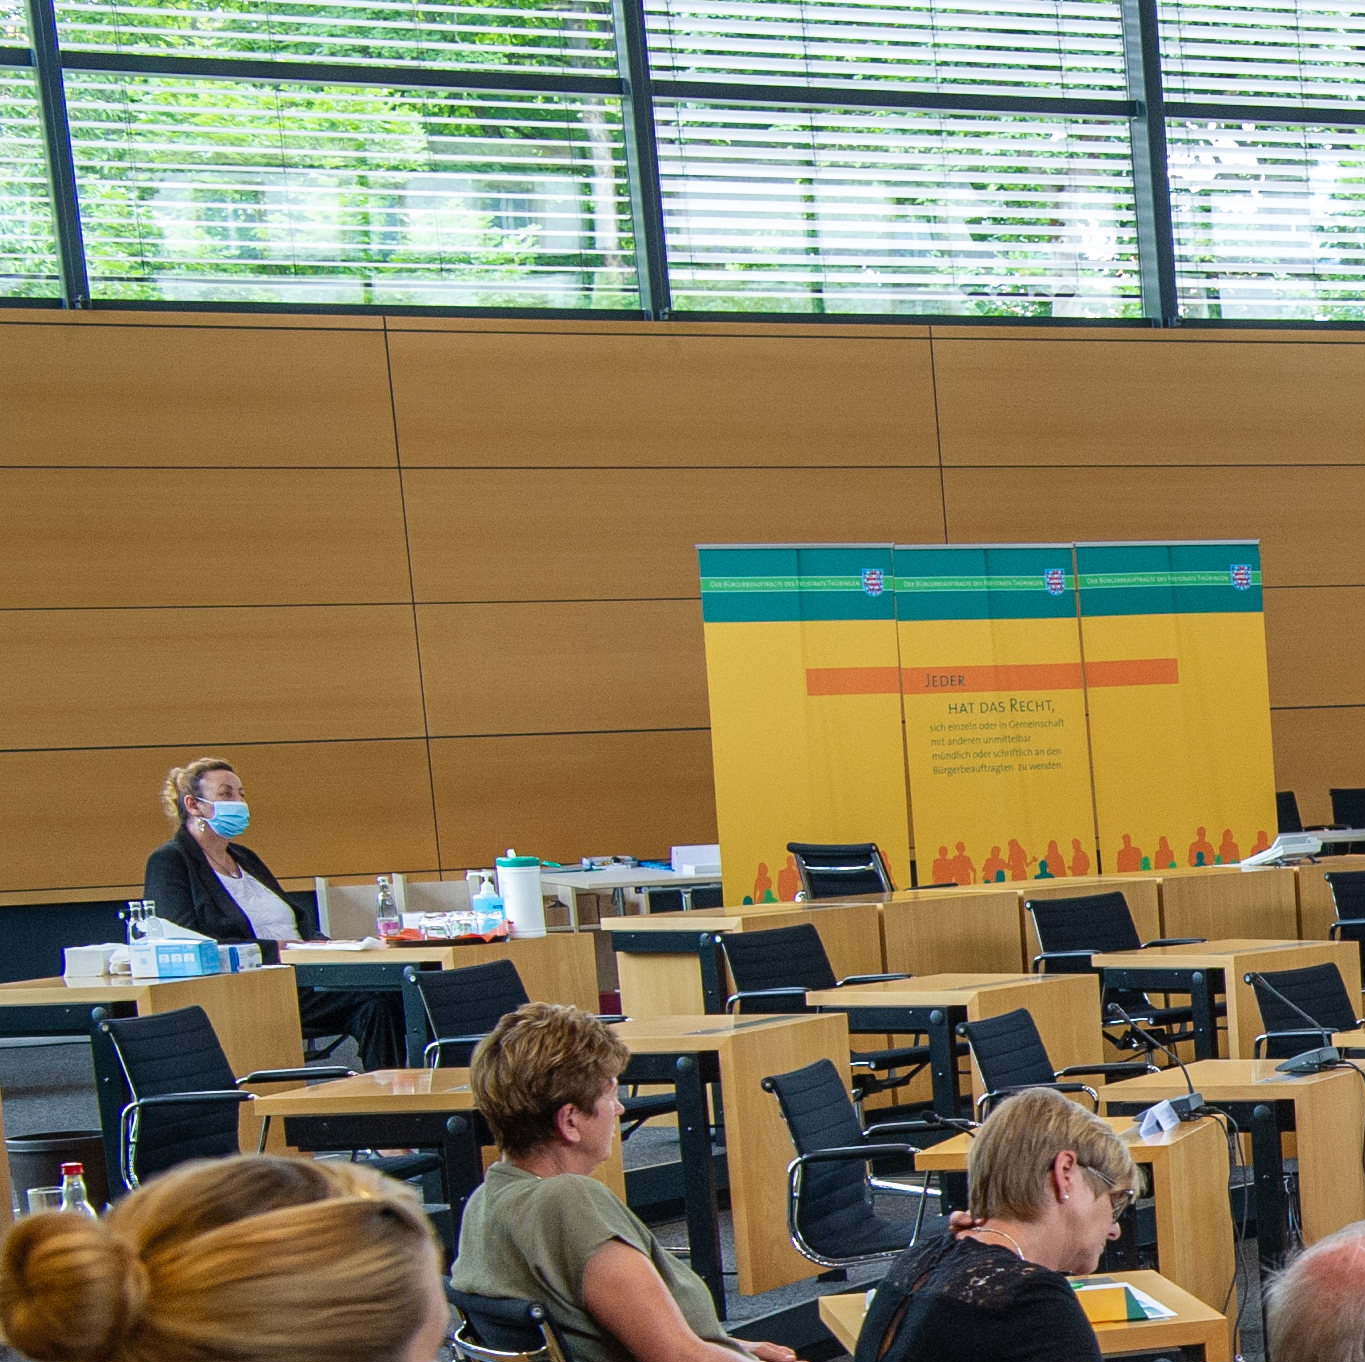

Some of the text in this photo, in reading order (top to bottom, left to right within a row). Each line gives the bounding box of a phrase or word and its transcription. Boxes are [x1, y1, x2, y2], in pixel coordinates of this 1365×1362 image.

[924, 673, 965, 688] JEDER
[948, 698, 1055, 714] HAT DAS RECHT,
[929, 718, 1064, 732] sich einzeln oder in Gemeinschaft
[930, 734, 1031, 746] mit anderen unmittelbar
[932, 751, 971, 760] mündlich
[972, 750, 991, 759] oder
[993, 748, 1033, 758] schriftlich
[1046, 747, 1062, 756] den
[932, 763, 1014, 777] Bürgerbeauftragten
[1017, 763, 1028, 772] zu
